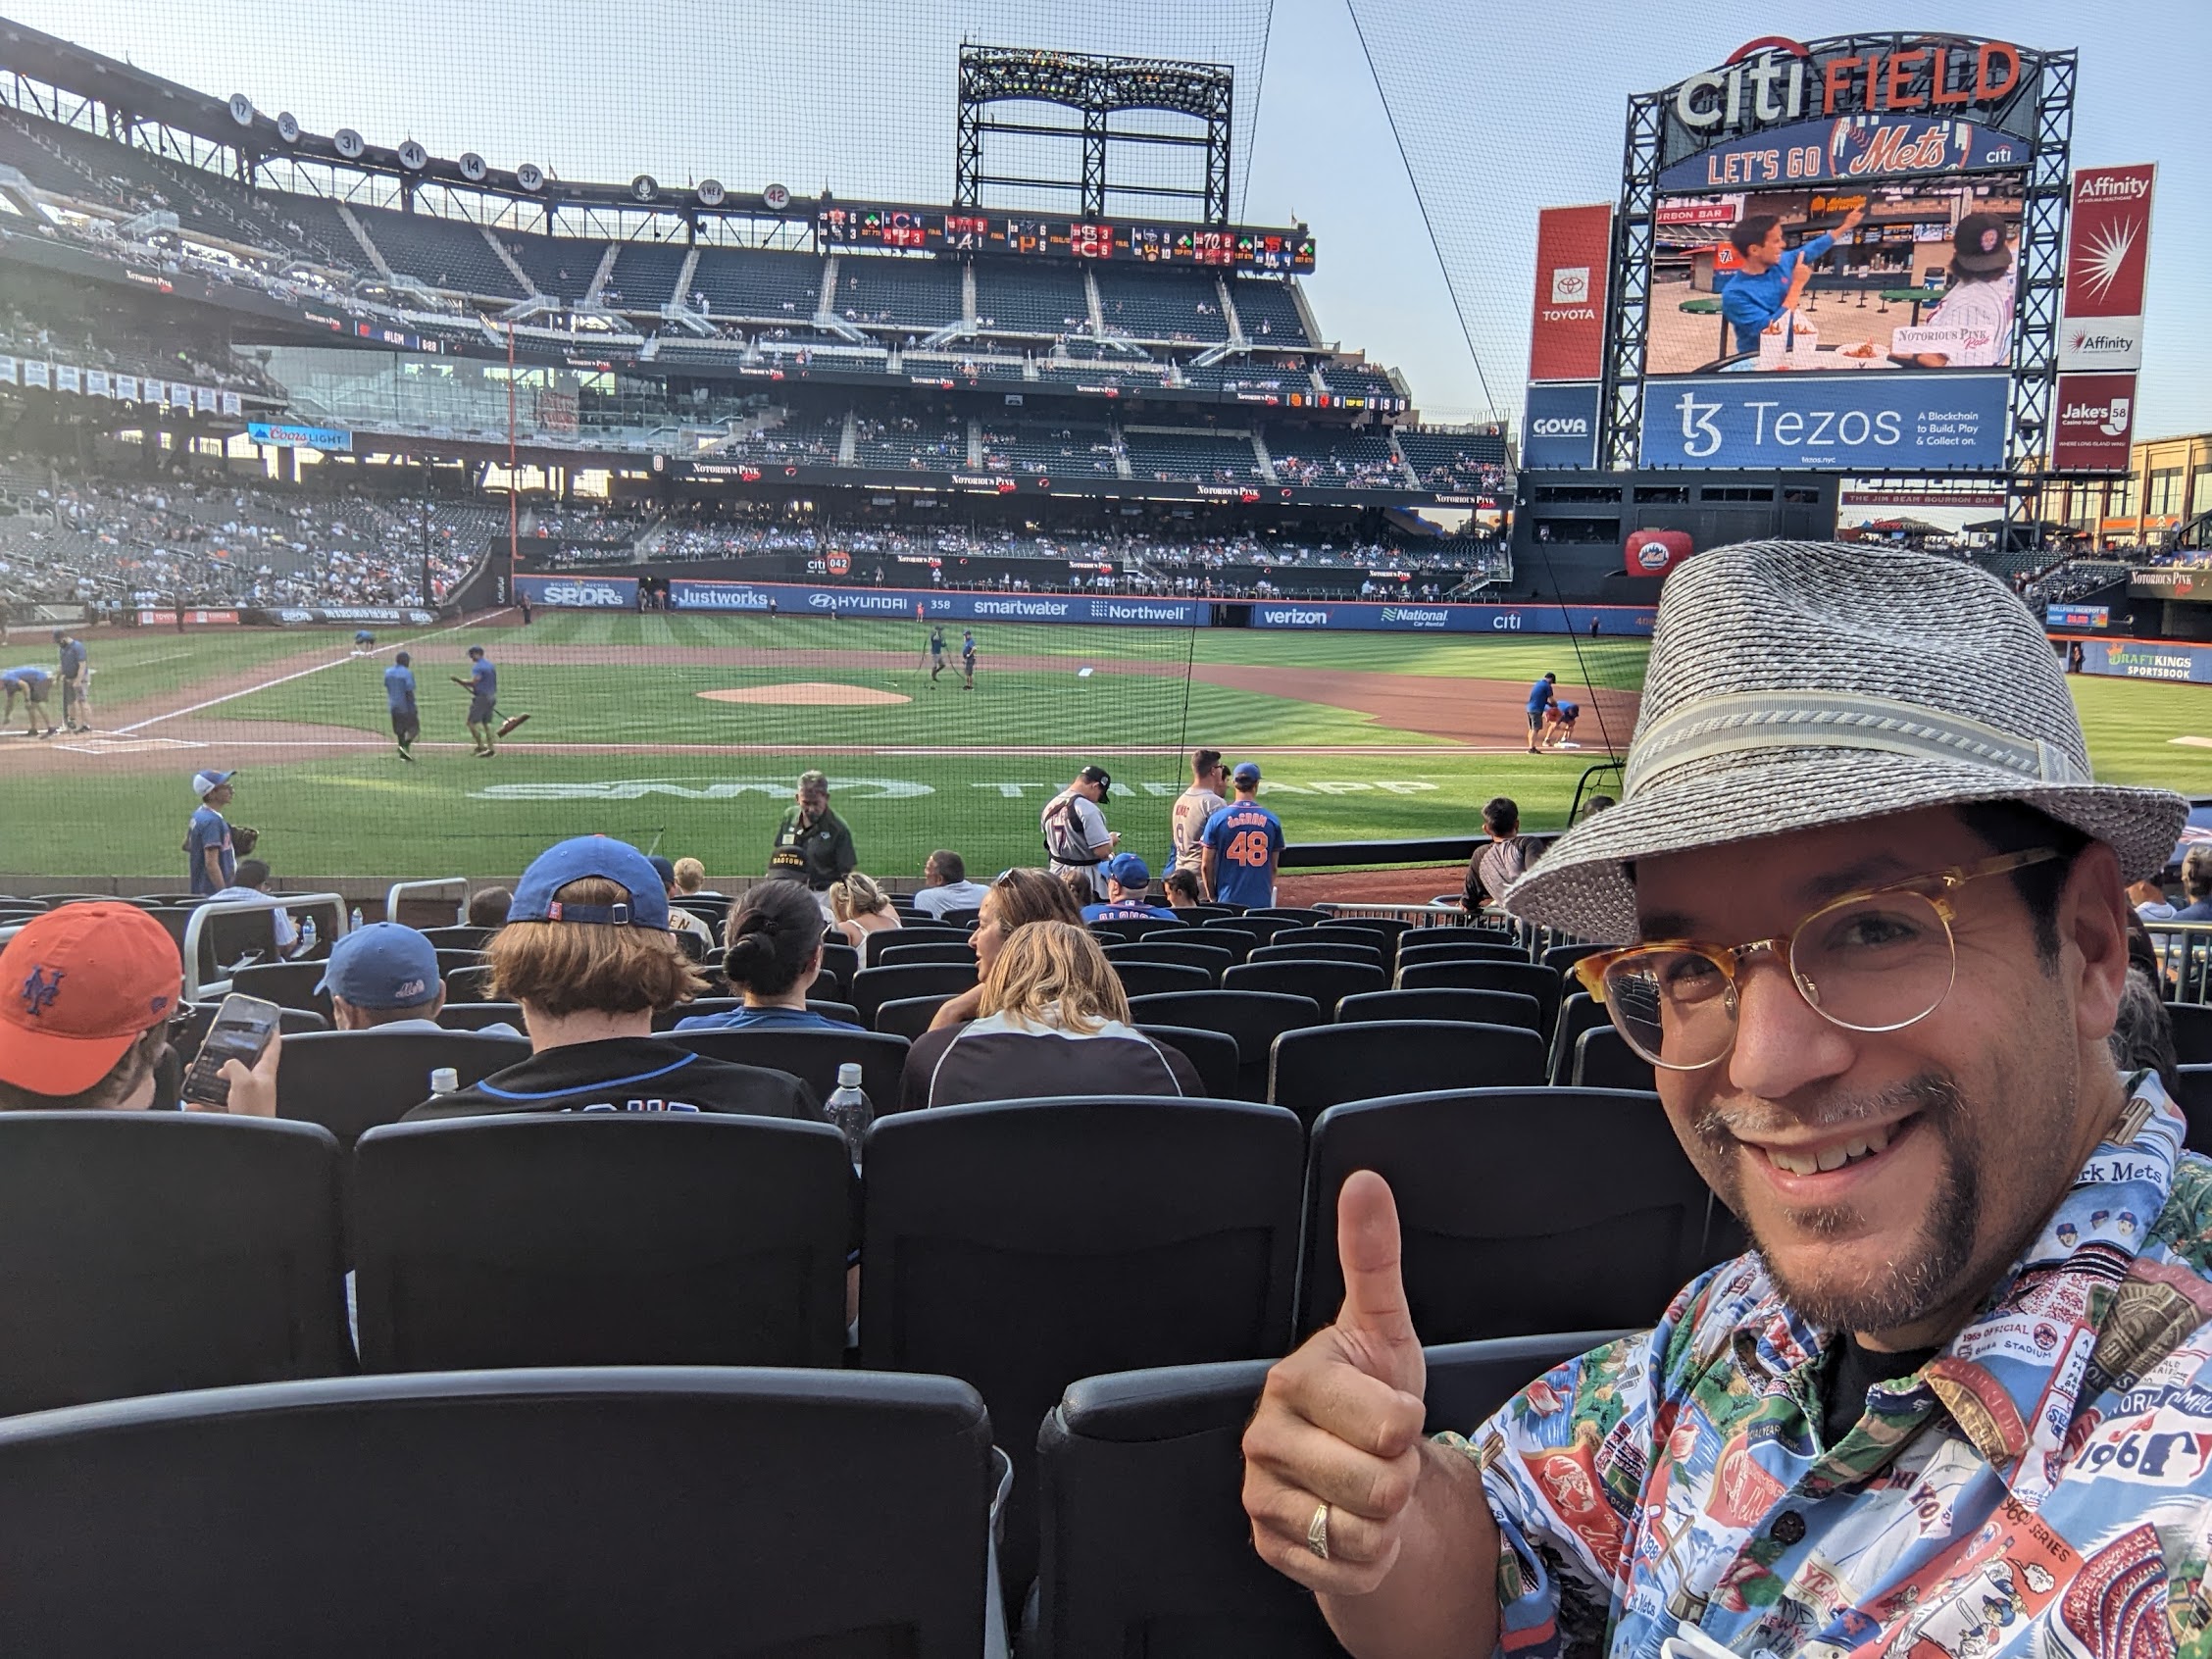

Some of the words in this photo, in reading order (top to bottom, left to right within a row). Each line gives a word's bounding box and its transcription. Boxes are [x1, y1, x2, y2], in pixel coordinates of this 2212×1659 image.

[1677, 36, 1809, 126] citi
[1824, 42, 2021, 114] FIELD
[234, 101, 246, 117] 17
[281, 120, 294, 135] 36
[342, 135, 357, 151] 31
[405, 148, 421, 162] 41
[1707, 146, 1779, 186] LET'S
[1786, 146, 1821, 177] GO
[1849, 125, 1948, 175] Mets
[1986, 146, 2011, 164] citi
[467, 160, 479, 173] 14
[522, 171, 537, 184] 37
[2079, 176, 2149, 198] Affinity
[769, 190, 784, 202] 42
[850, 228, 857, 239] 3
[914, 232, 921, 243] 3
[1101, 229, 1108, 240] 3
[1284, 240, 1291, 251] 4
[1161, 248, 1172, 260] 10
[1224, 253, 1230, 264] 3
[1284, 256, 1290, 267] 4
[1542, 309, 1595, 321] TOYOTA
[2084, 335, 2133, 352] Affinity
[1383, 399, 1389, 410] S
[2061, 403, 2108, 419] Jake's
[2112, 408, 2126, 418] 58
[1743, 401, 1902, 446] Tezos
[1918, 412, 1926, 421] A
[1928, 412, 1979, 421] Blockchain
[1533, 419, 1587, 434] GOYA
[1930, 424, 1955, 434] Build,
[1958, 424, 1979, 434] Play
[270, 425, 307, 443] Coors
[309, 432, 341, 444] LIGHT
[1916, 436, 1924, 445] &
[738, 465, 759, 475] PINK
[995, 476, 1015, 486] PINK
[1239, 486, 1259, 495] PINK
[1434, 493, 1475, 504] NOTORIOUS
[1476, 494, 1494, 504] PINK
[807, 559, 826, 570] citi
[830, 559, 847, 568] 042
[2131, 571, 2172, 585] NOTORIOUS
[2173, 572, 2192, 585] PINK
[679, 588, 768, 605] Justworks
[838, 595, 907, 609] HYUNDAI
[931, 600, 951, 610] 358
[974, 600, 1069, 616] smartwater
[1109, 605, 1184, 620] Northwell
[1264, 608, 1328, 625] verizon
[1396, 609, 1447, 621] National
[1493, 612, 1521, 629] citi
[2108, 653, 2191, 668] DRAFTKINGS
[2128, 666, 2190, 679] SPORTSBOOK
[1053, 825, 1067, 852] 7
[1226, 830, 1269, 867] 48
[669, 914, 690, 930] EN
[2112, 1161, 2162, 1183] Mets
[1984, 1323, 2030, 1337] OFFICIAL
[2003, 1340, 2052, 1358] STADIUM
[2029, 1524, 2071, 1562] SERIES
